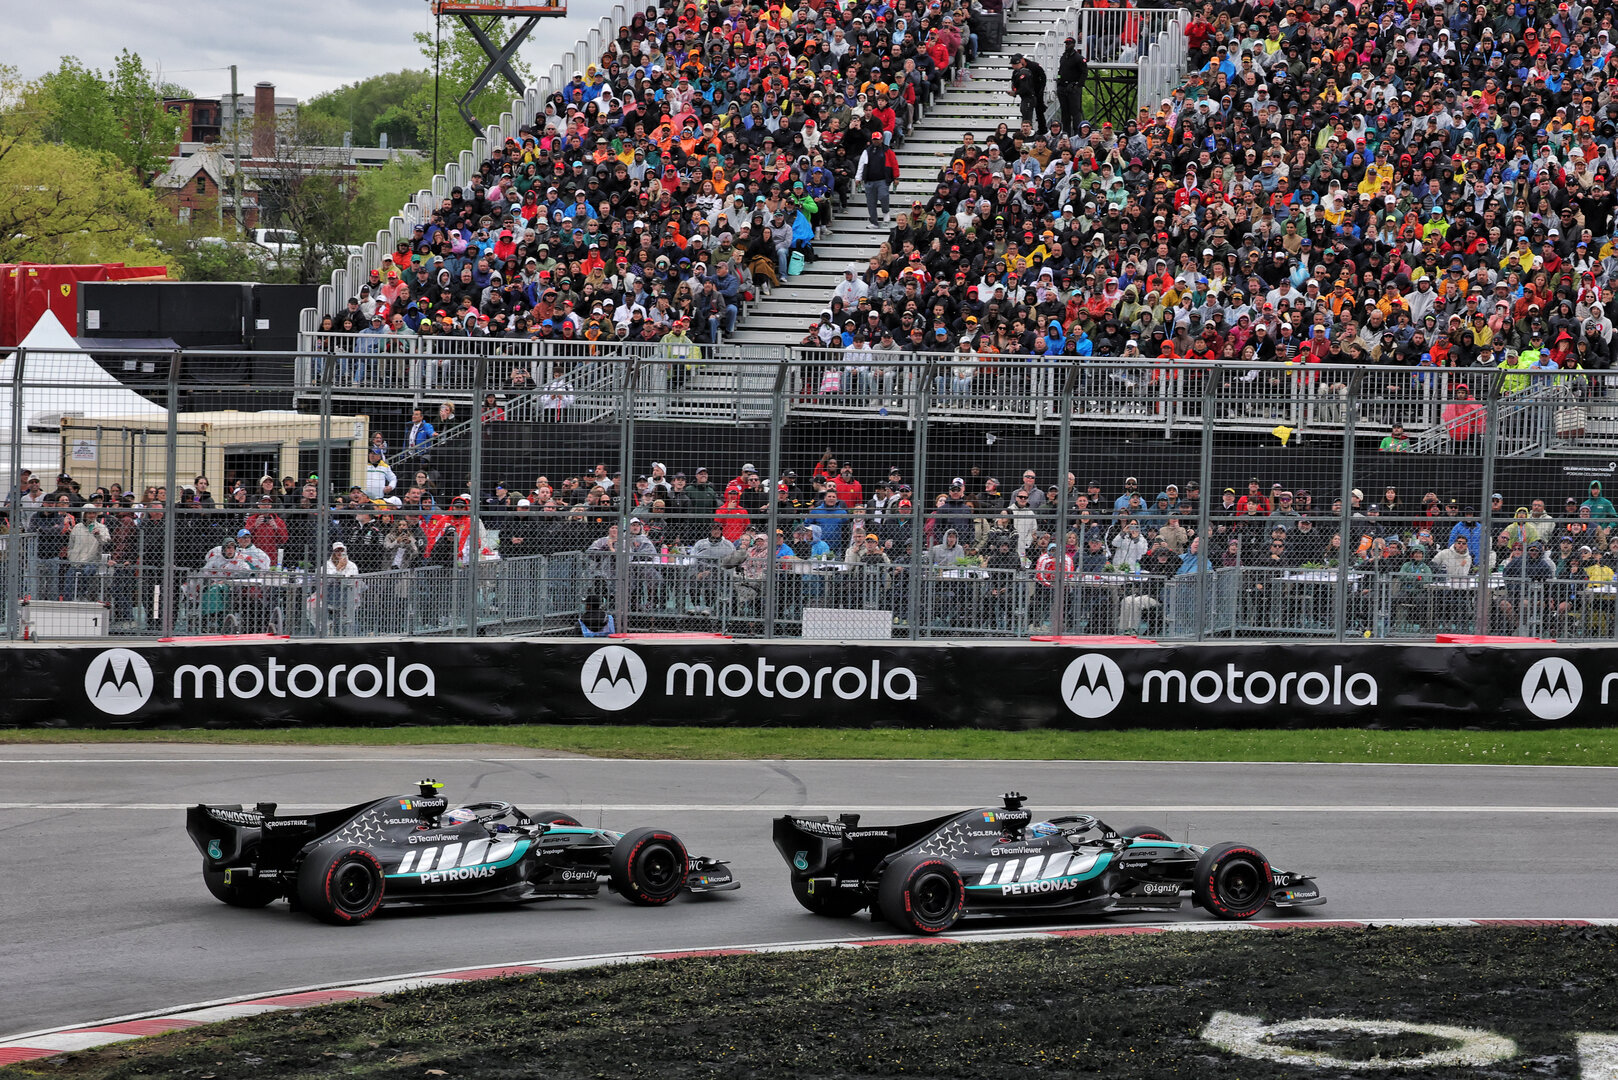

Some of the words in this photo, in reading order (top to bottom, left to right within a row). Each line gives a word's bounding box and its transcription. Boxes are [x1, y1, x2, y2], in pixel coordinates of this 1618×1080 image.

[92, 618, 98, 626] 1
[173, 656, 436, 698] motorola
[666, 657, 918, 700] motorola
[1142, 663, 1378, 706] motorola
[412, 798, 444, 808] Microsoft
[995, 812, 1028, 820] Microsoft
[417, 834, 460, 842] TeamViewer
[688, 860, 704, 870] WC
[420, 866, 496, 884] PETRONAS
[562, 870, 598, 880] signify
[1274, 876, 1290, 886] WC
[1002, 878, 1078, 896] PETRONAS
[1144, 884, 1180, 894] signify
